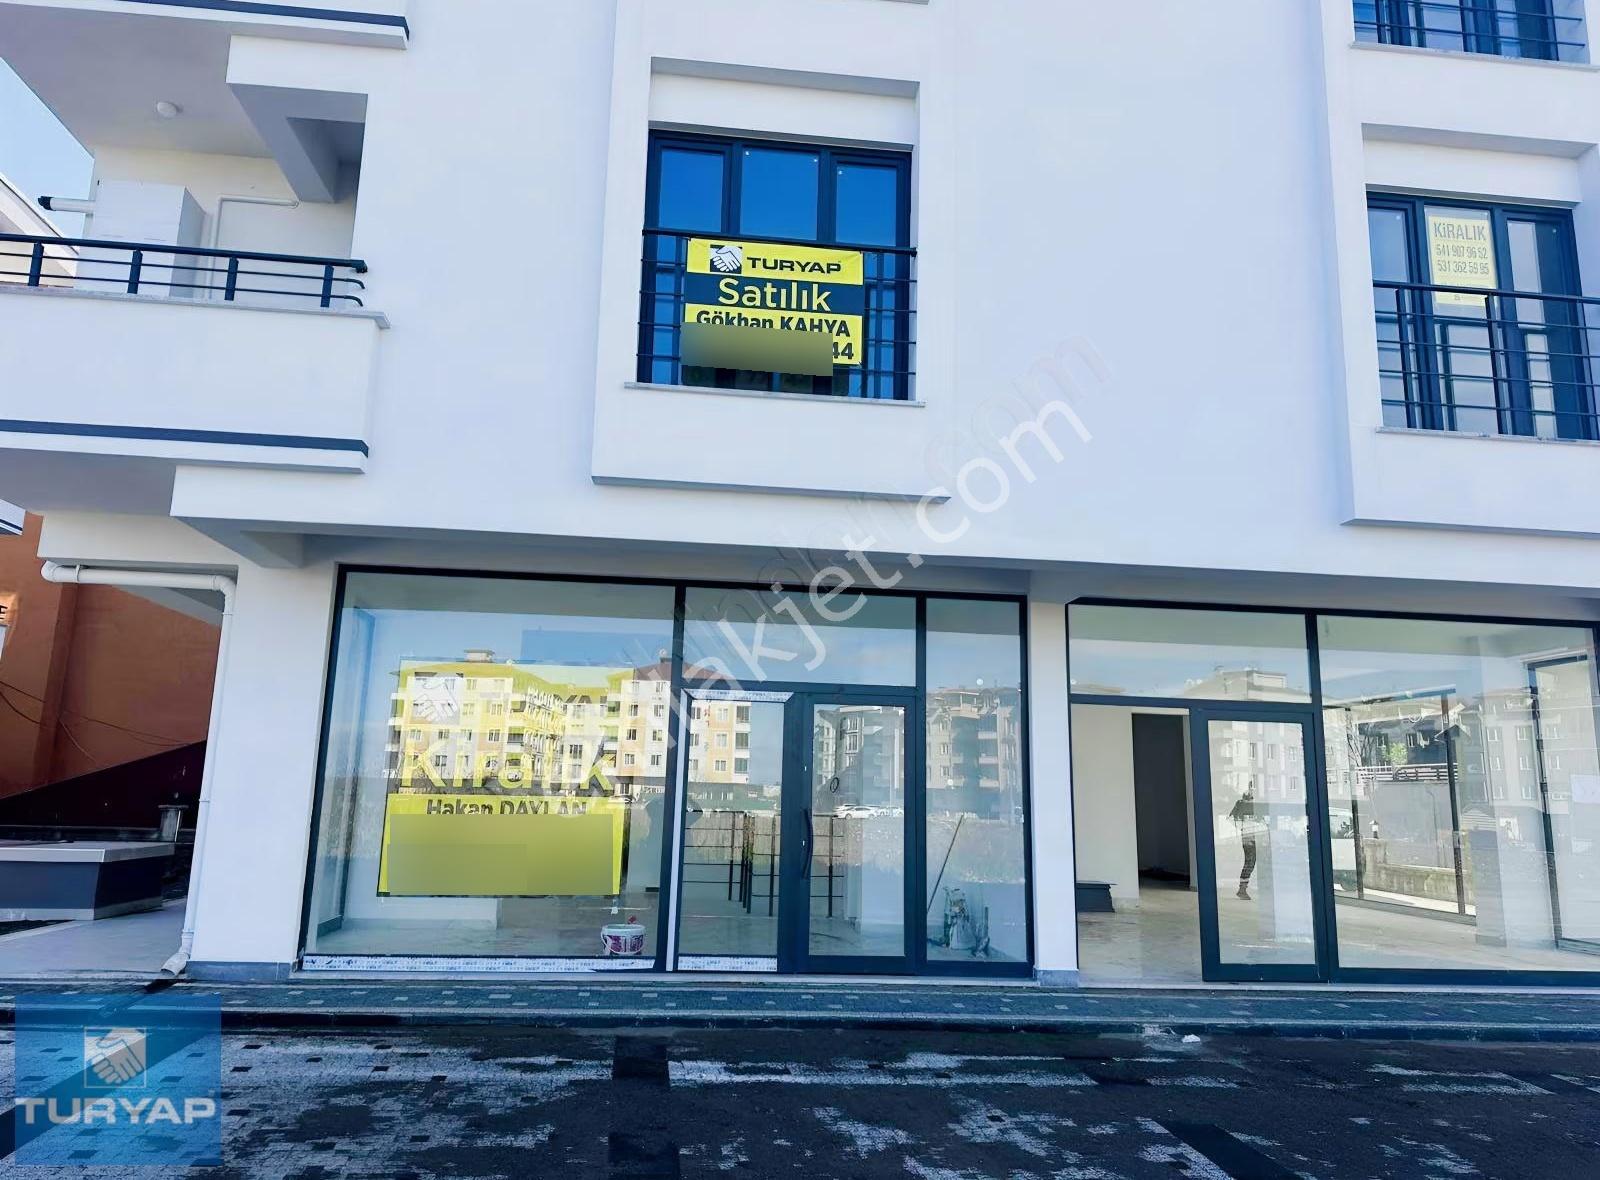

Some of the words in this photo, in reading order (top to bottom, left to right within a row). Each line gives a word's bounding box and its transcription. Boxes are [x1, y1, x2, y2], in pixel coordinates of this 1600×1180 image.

[746, 256, 842, 274] TURYAP
[718, 278, 832, 312] Satılık
[780, 315, 851, 338] KAHYA
